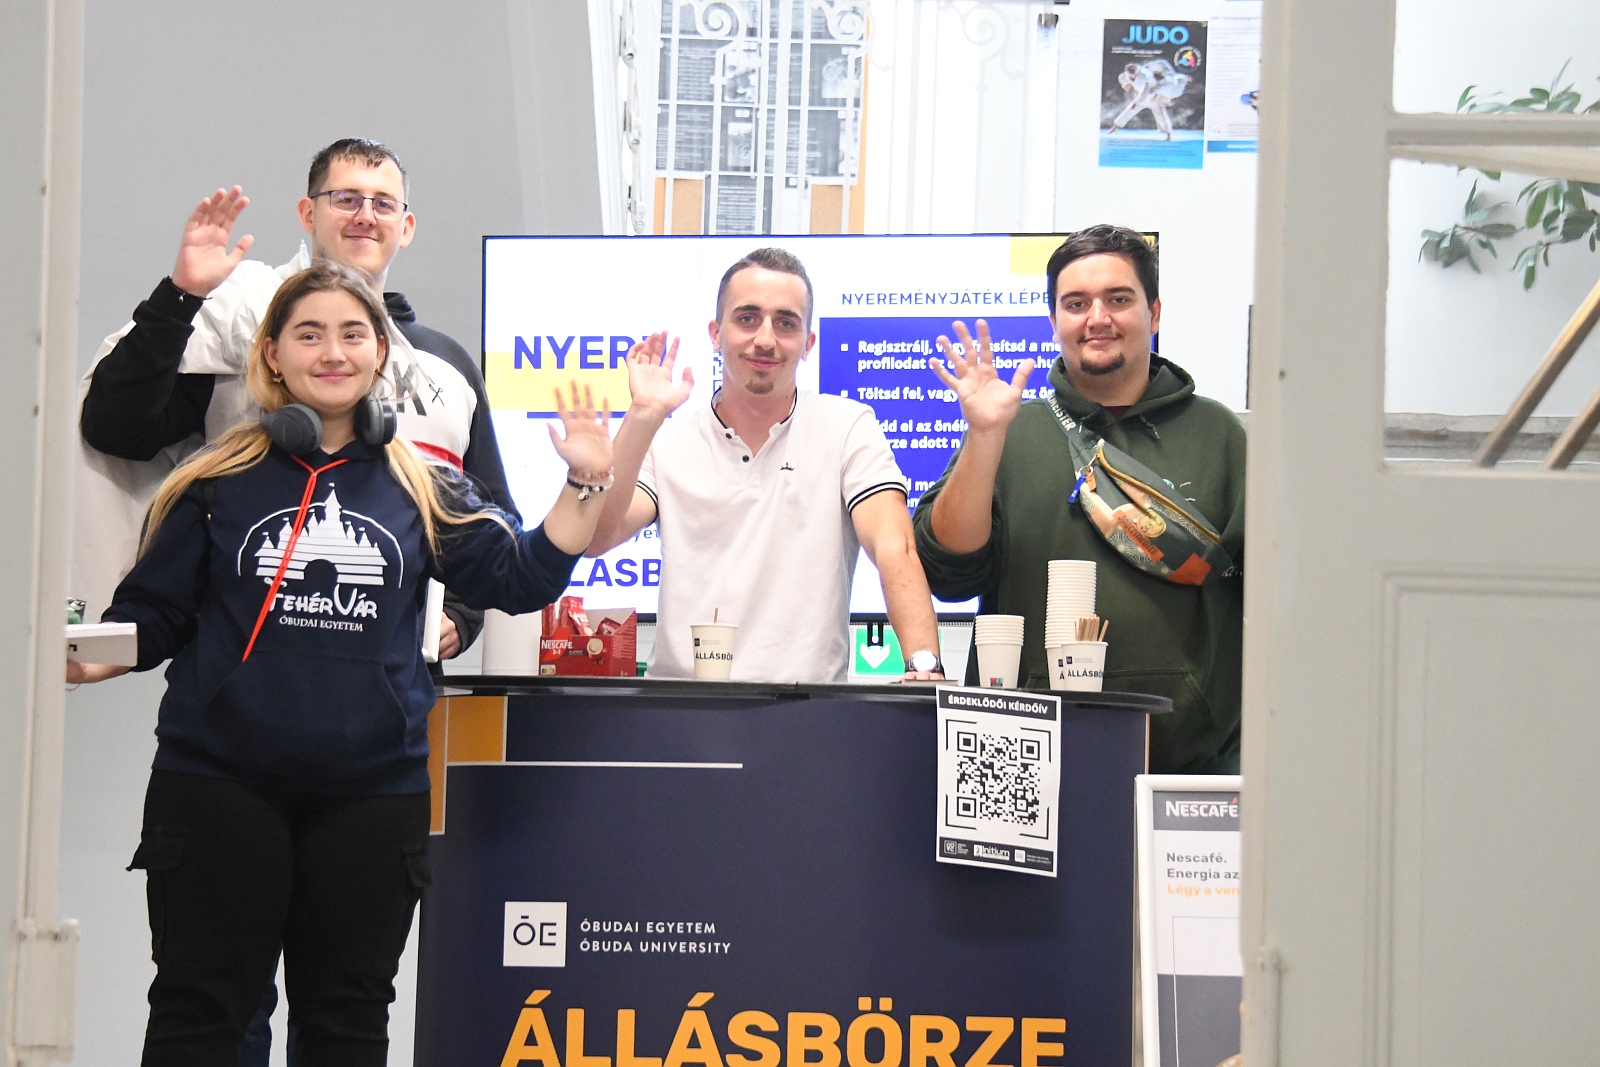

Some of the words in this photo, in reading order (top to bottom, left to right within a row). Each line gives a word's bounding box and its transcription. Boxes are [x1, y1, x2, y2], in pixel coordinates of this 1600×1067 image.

[1122, 25, 1189, 45] JUDO
[841, 289, 1003, 305] NYEREMÉNYJÁTÉK
[858, 340, 933, 355] Regisztrálj,
[1028, 342, 1038, 352] a
[857, 356, 927, 372] profilodat
[857, 387, 903, 400] Töltsd
[903, 387, 925, 401] fel,
[927, 390, 958, 402] vagy
[900, 420, 913, 432] el
[916, 422, 931, 432] az
[910, 436, 948, 448] adott
[279, 615, 317, 628] ÓBUDAI
[320, 620, 363, 632] EGYETEM
[948, 695, 1006, 710] ÉRDEKLŐDŐI
[1008, 701, 1049, 715] KÉRDŐÍV
[1165, 797, 1238, 818] NESCAFÉ
[1166, 852, 1227, 864] Nescafé.
[1166, 868, 1220, 881] Energia
[1224, 871, 1239, 879] az
[1168, 884, 1200, 897] Légy
[1204, 887, 1212, 895] a
[580, 918, 640, 933] ÓBUDAI
[646, 920, 716, 934] EGYETEM
[579, 938, 633, 953] ÓBUDA
[639, 940, 732, 955] UNIVERSITY
[500, 989, 1067, 1067] ÁLLÁSBÖRZE
